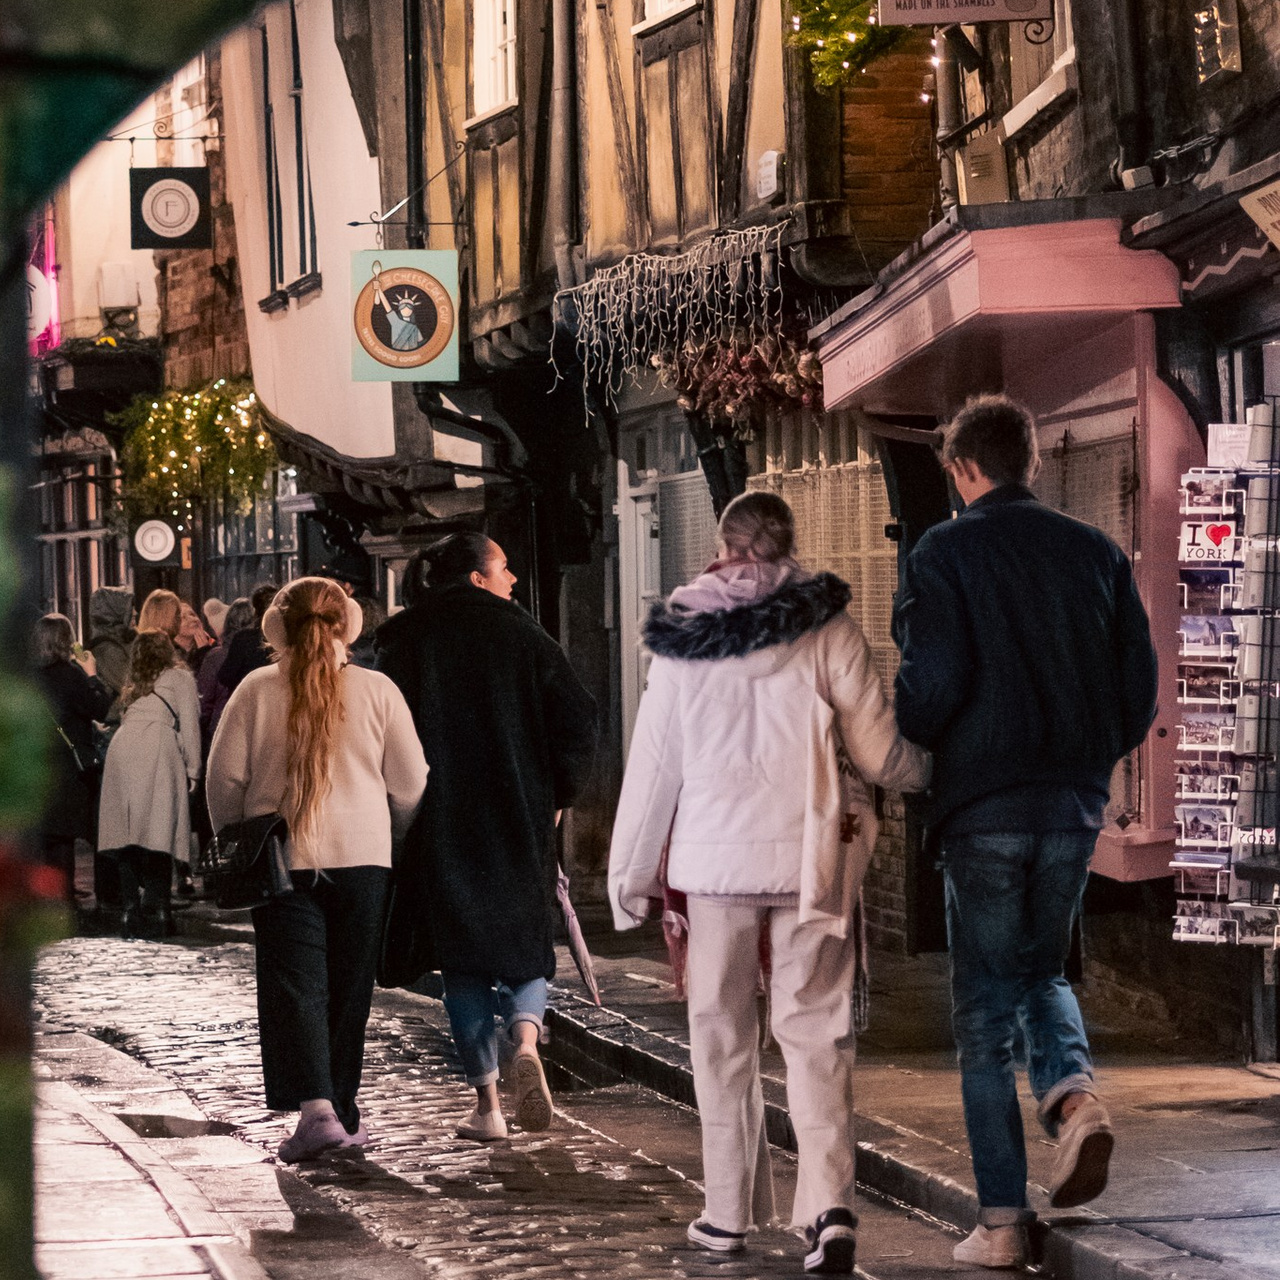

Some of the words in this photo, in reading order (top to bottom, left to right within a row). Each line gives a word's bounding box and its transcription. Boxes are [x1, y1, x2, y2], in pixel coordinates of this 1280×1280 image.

[393, 273, 445, 303] CHEESECAKE
[439, 305, 449, 324] GUY
[1187, 524, 1202, 547] I
[1187, 548, 1226, 560] YORK
